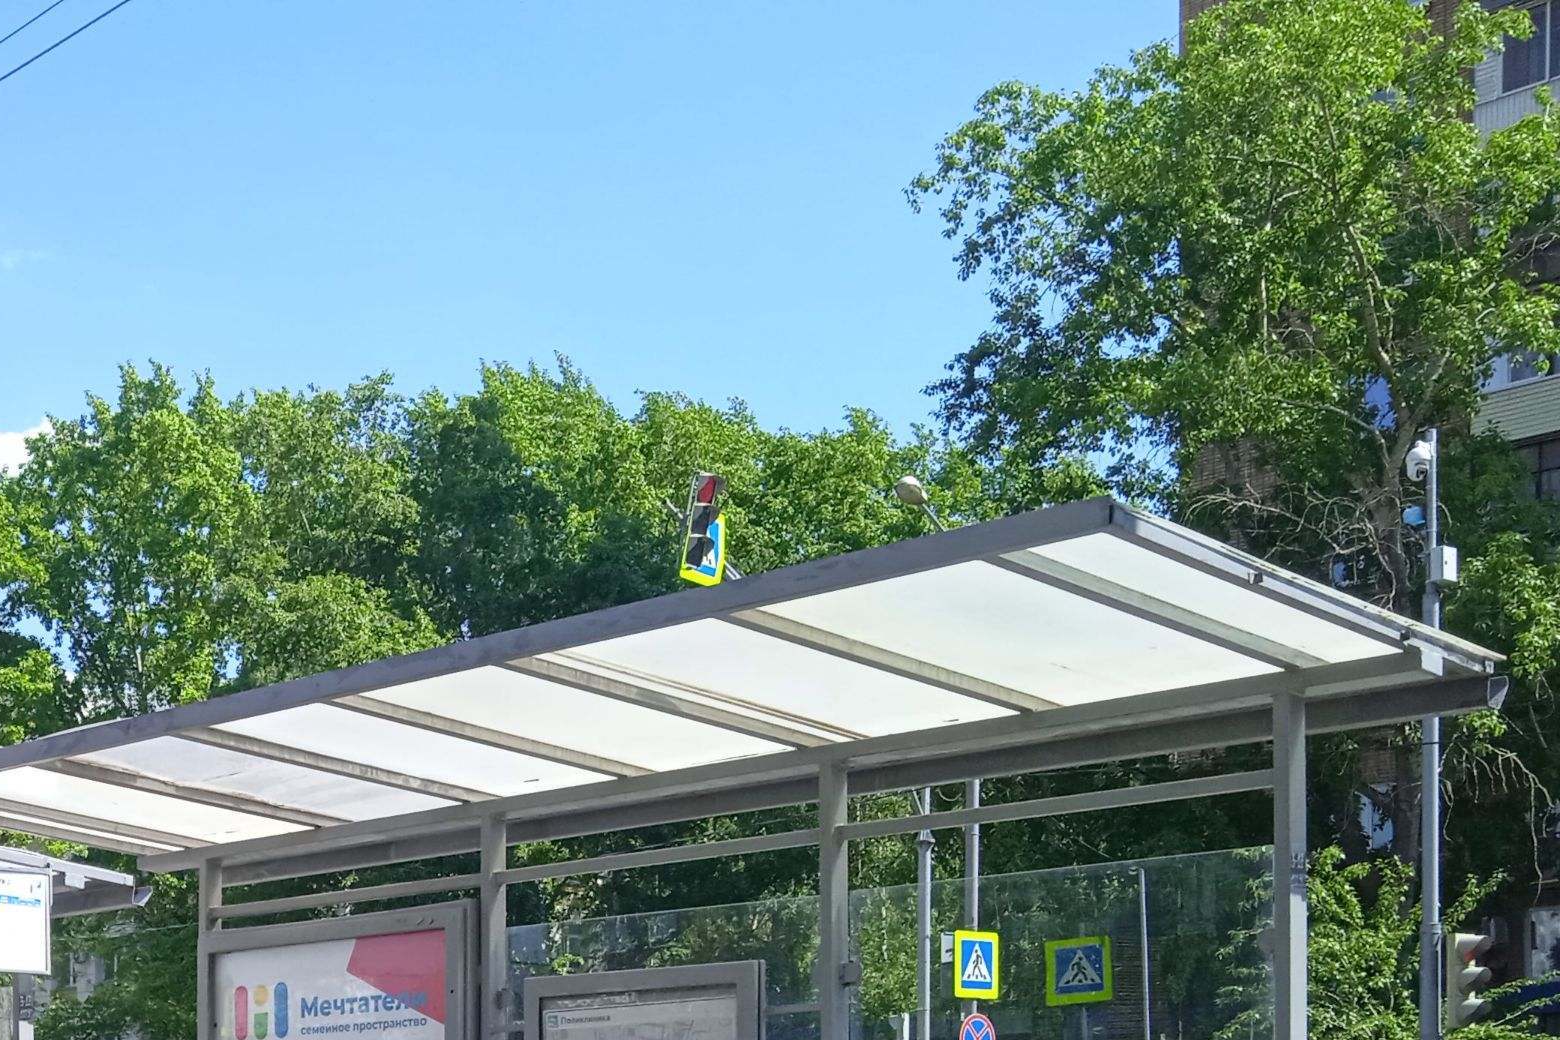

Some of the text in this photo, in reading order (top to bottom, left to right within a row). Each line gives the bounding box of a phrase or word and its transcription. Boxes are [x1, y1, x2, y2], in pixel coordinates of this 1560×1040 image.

[300, 991, 427, 1018] Мечтатели
[300, 1017, 427, 1035] семейное пространство
